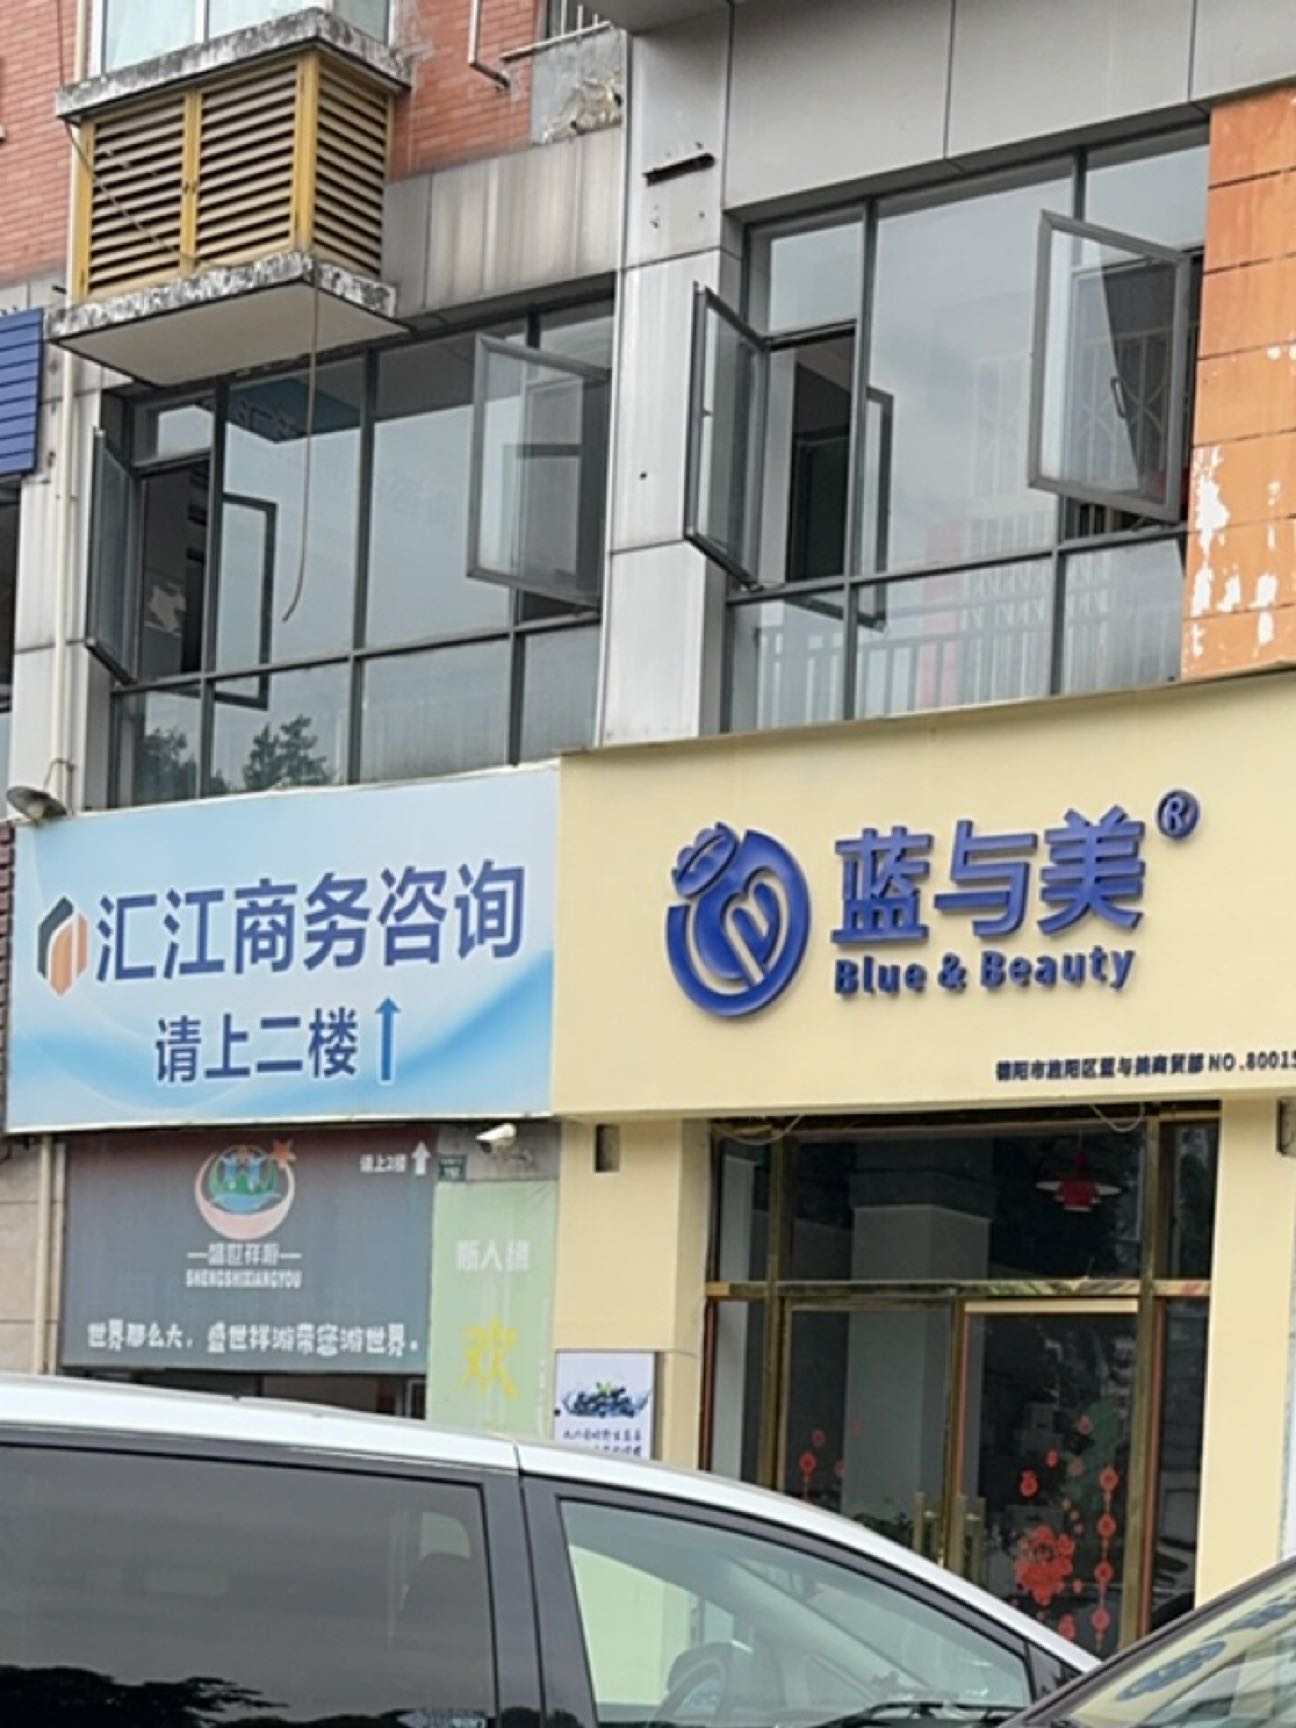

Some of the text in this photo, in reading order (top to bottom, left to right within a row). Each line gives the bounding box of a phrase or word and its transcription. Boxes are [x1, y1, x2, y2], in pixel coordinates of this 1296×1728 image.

[95, 858, 526, 983] 汇江商务咨询
[831, 805, 1146, 944] 蓝与美
[834, 946, 1136, 995] Blue & Beauty
[155, 1006, 359, 1083] 请上二楼
